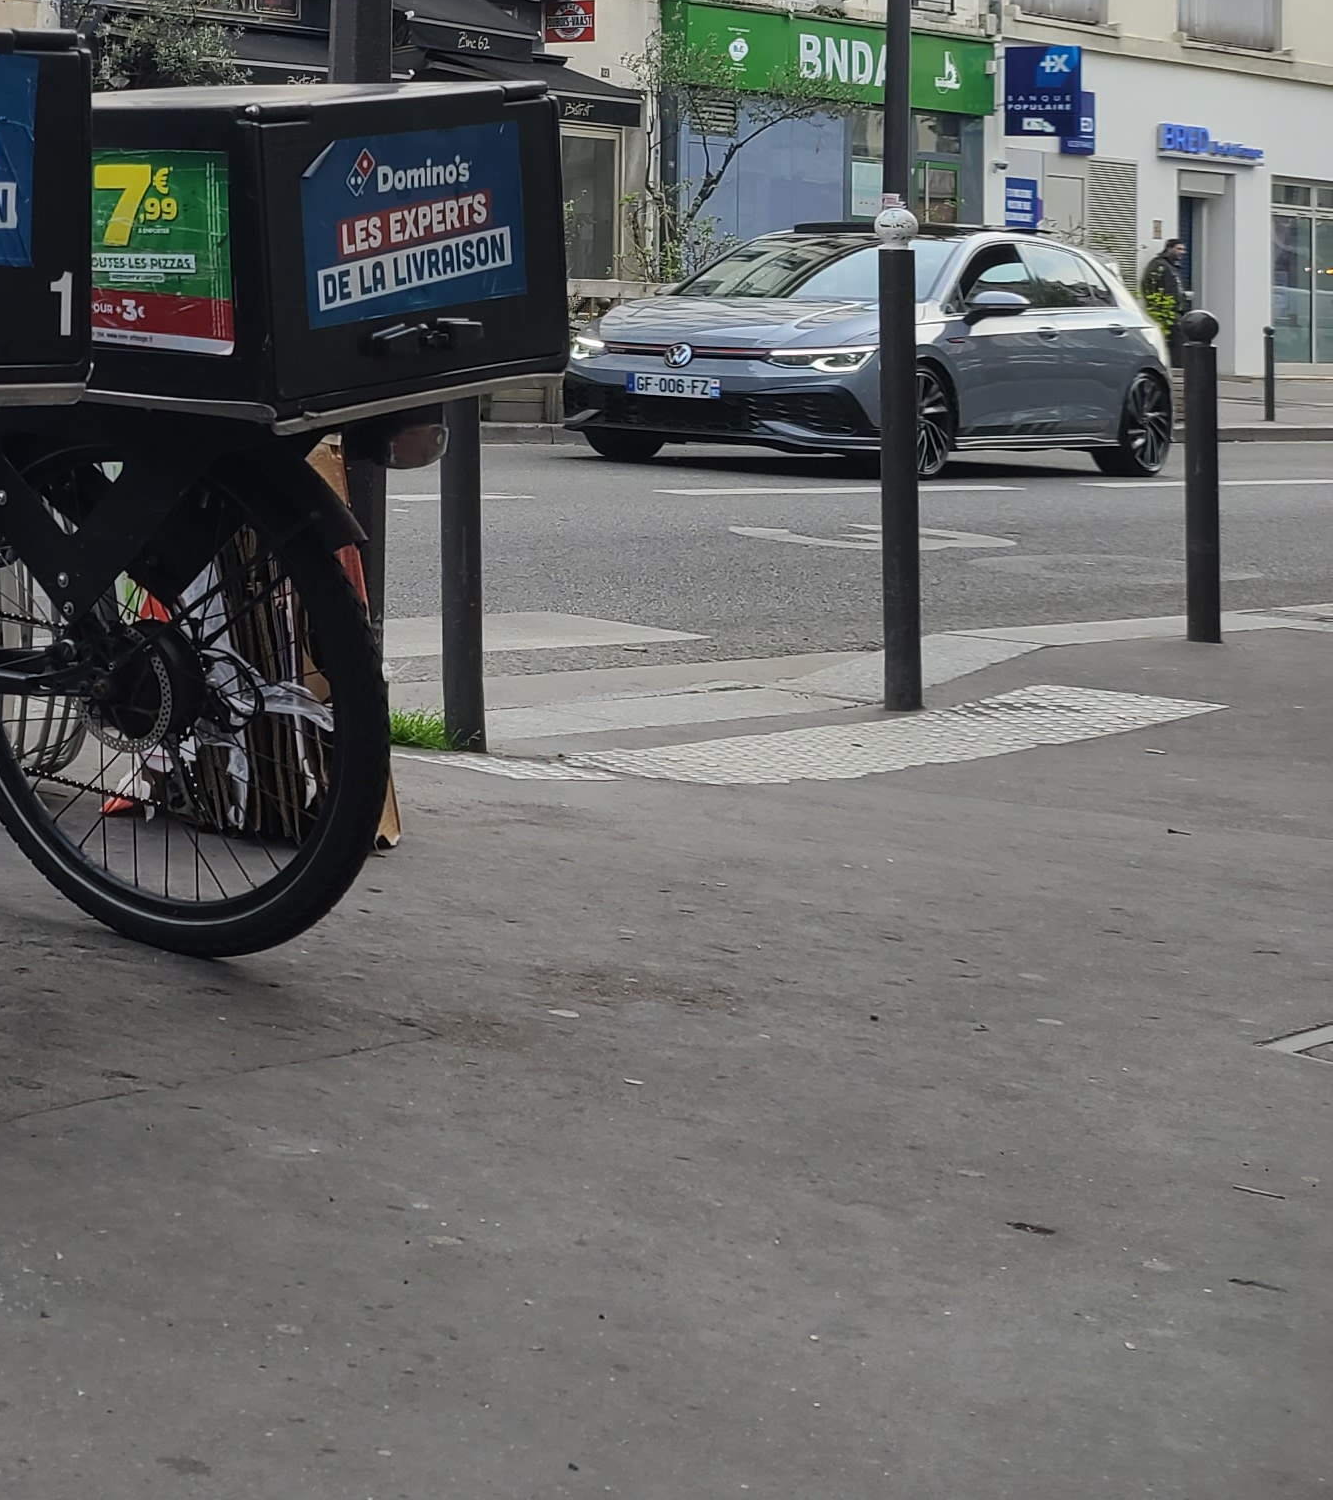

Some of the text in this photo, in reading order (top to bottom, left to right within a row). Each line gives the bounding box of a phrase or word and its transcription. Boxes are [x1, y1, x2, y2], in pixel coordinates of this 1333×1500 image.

[457, 31, 491, 51] Zinc 62
[1007, 94, 1072, 102] BANQUE
[1007, 103, 1072, 111] POPULAIRE
[1162, 122, 1210, 153] BRED
[377, 154, 471, 193] Domino's
[94, 163, 152, 246] 7
[341, 193, 488, 255] LES EXPERTS
[91, 257, 191, 270] OUTES LES PIZZAS
[322, 232, 507, 305] DE LA LIVRAISON
[49, 271, 73, 337] 1
[91, 302, 114, 315] OUR
[636, 376, 709, 396] GF-006-FZ
